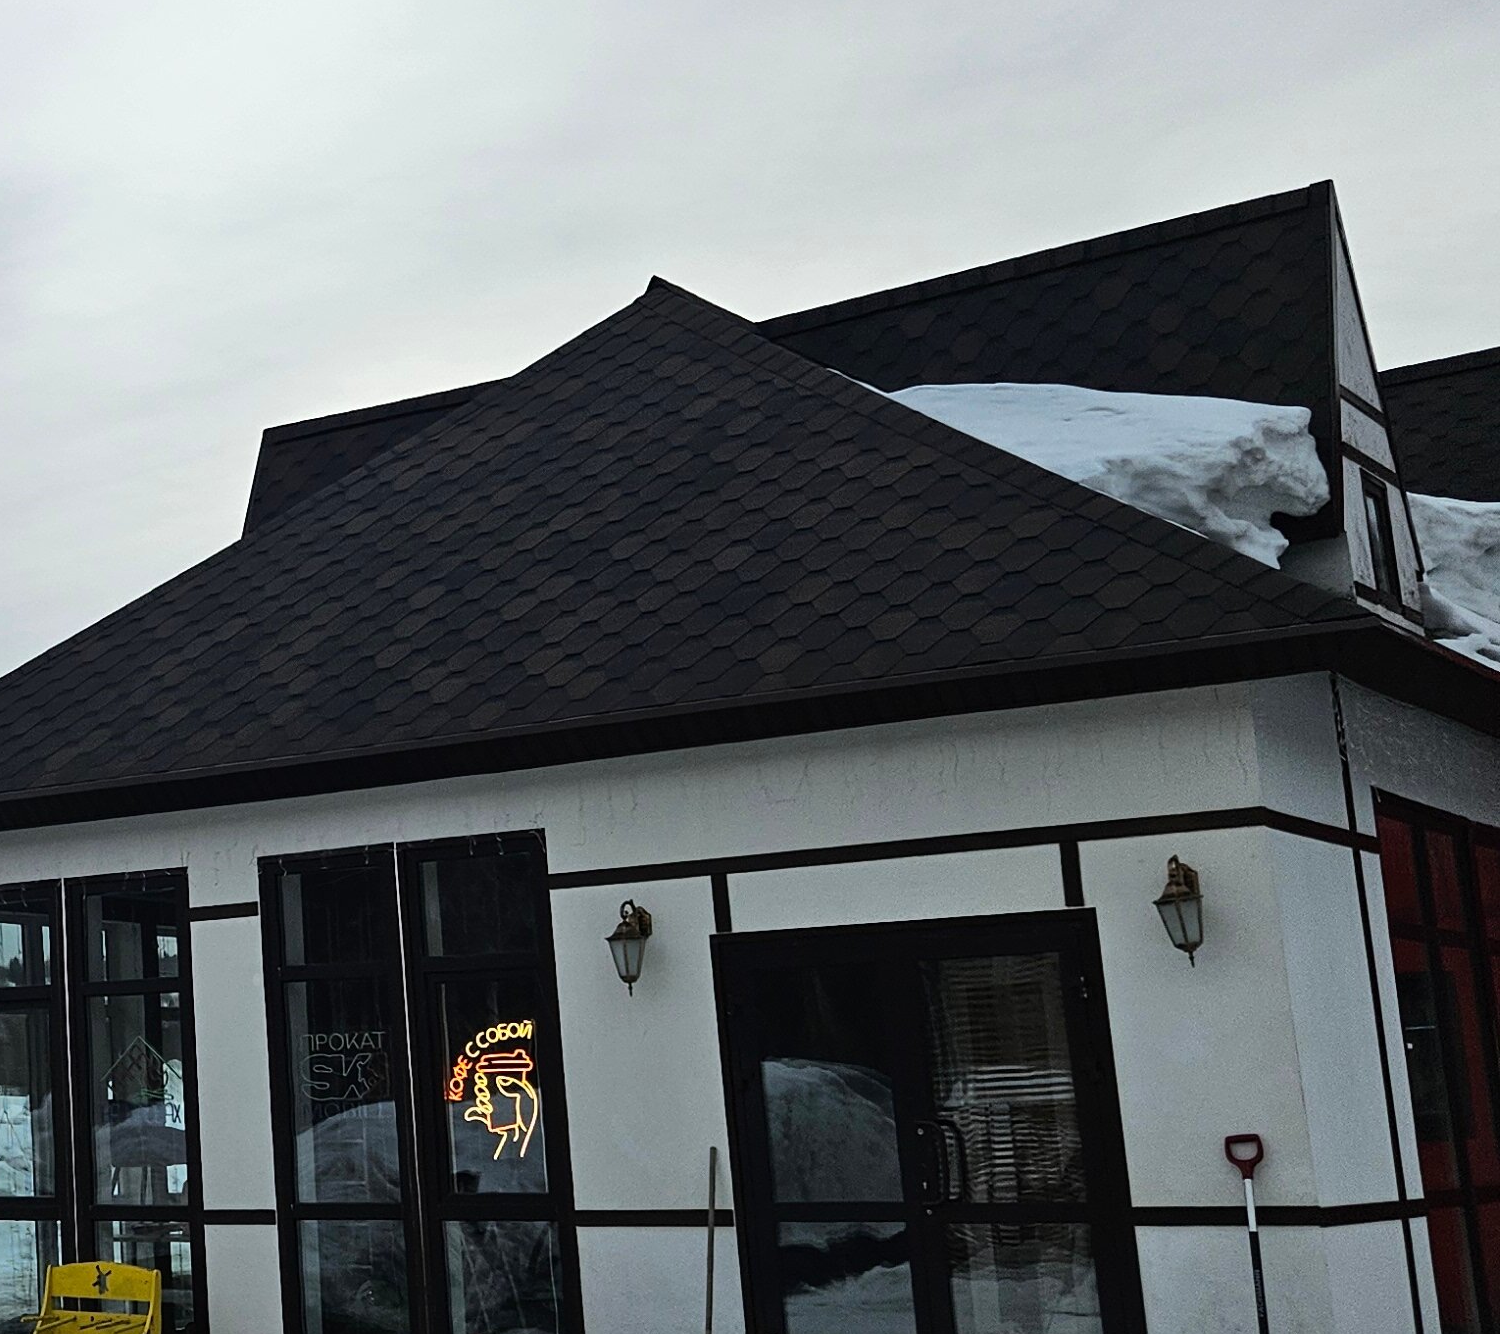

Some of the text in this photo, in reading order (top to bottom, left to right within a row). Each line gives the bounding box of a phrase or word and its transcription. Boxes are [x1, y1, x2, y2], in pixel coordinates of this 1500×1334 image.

[302, 1031, 386, 1052] ПРОКАТ
[448, 1055, 473, 1101] КОФЕ
[475, 1019, 533, 1048] СОБОЙ
